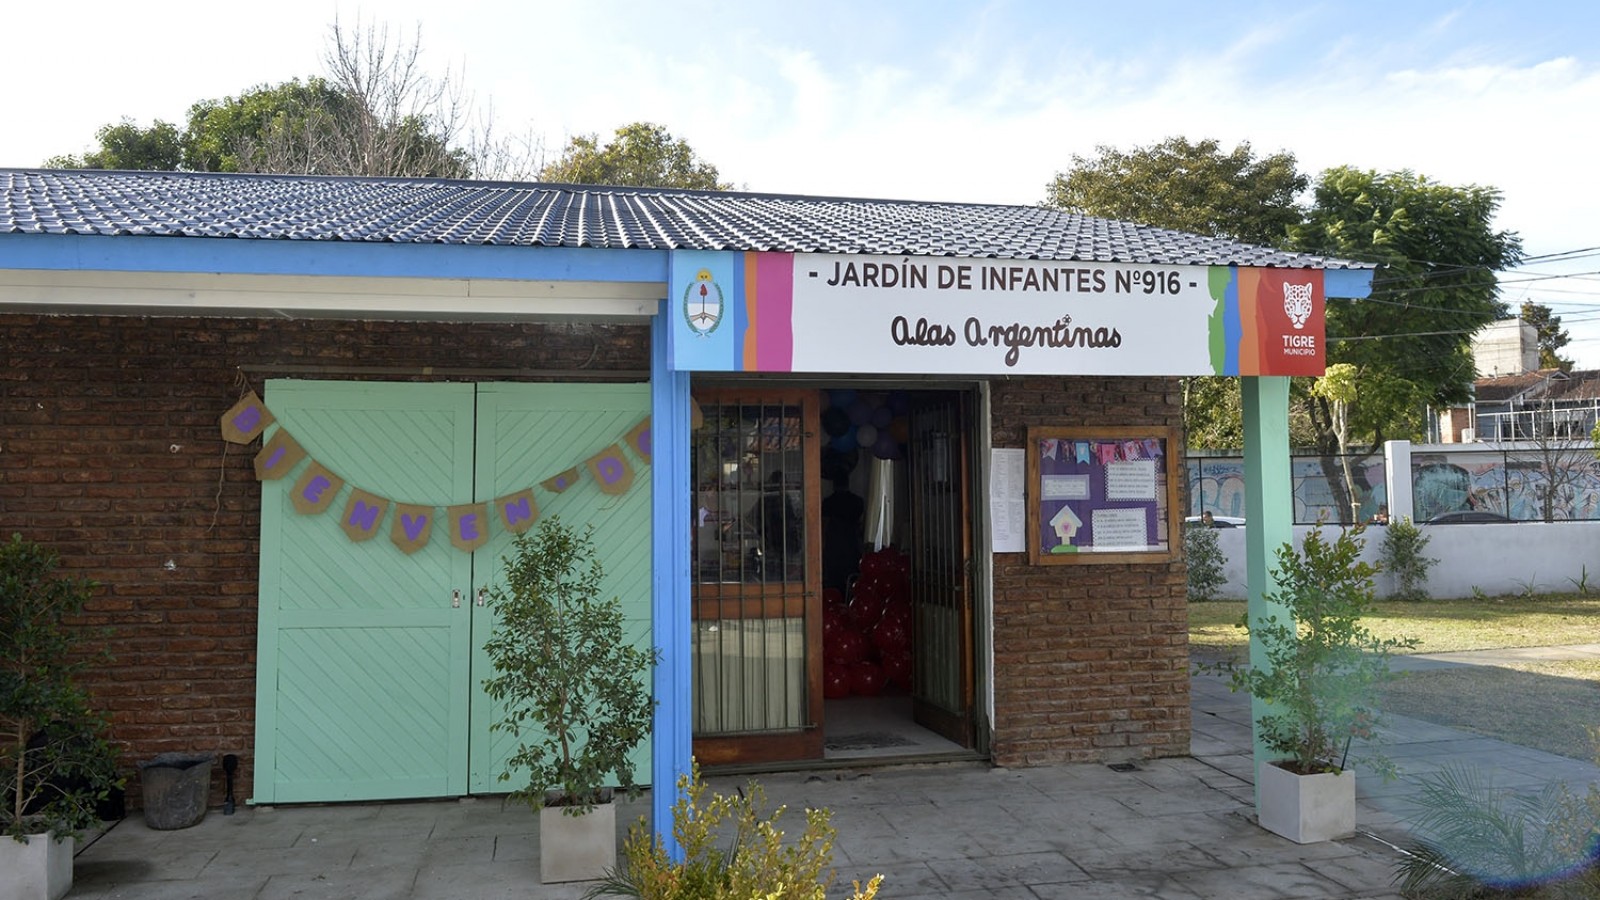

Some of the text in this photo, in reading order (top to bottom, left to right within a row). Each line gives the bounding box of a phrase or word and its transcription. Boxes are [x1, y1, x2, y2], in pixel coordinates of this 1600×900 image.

[826, 256, 929, 291] JARDÍN
[937, 265, 973, 291] DE
[981, 265, 1107, 294] INFANTES
[1282, 335, 1316, 349] TIGRE
[1283, 348, 1317, 357] MUNICIPIO
